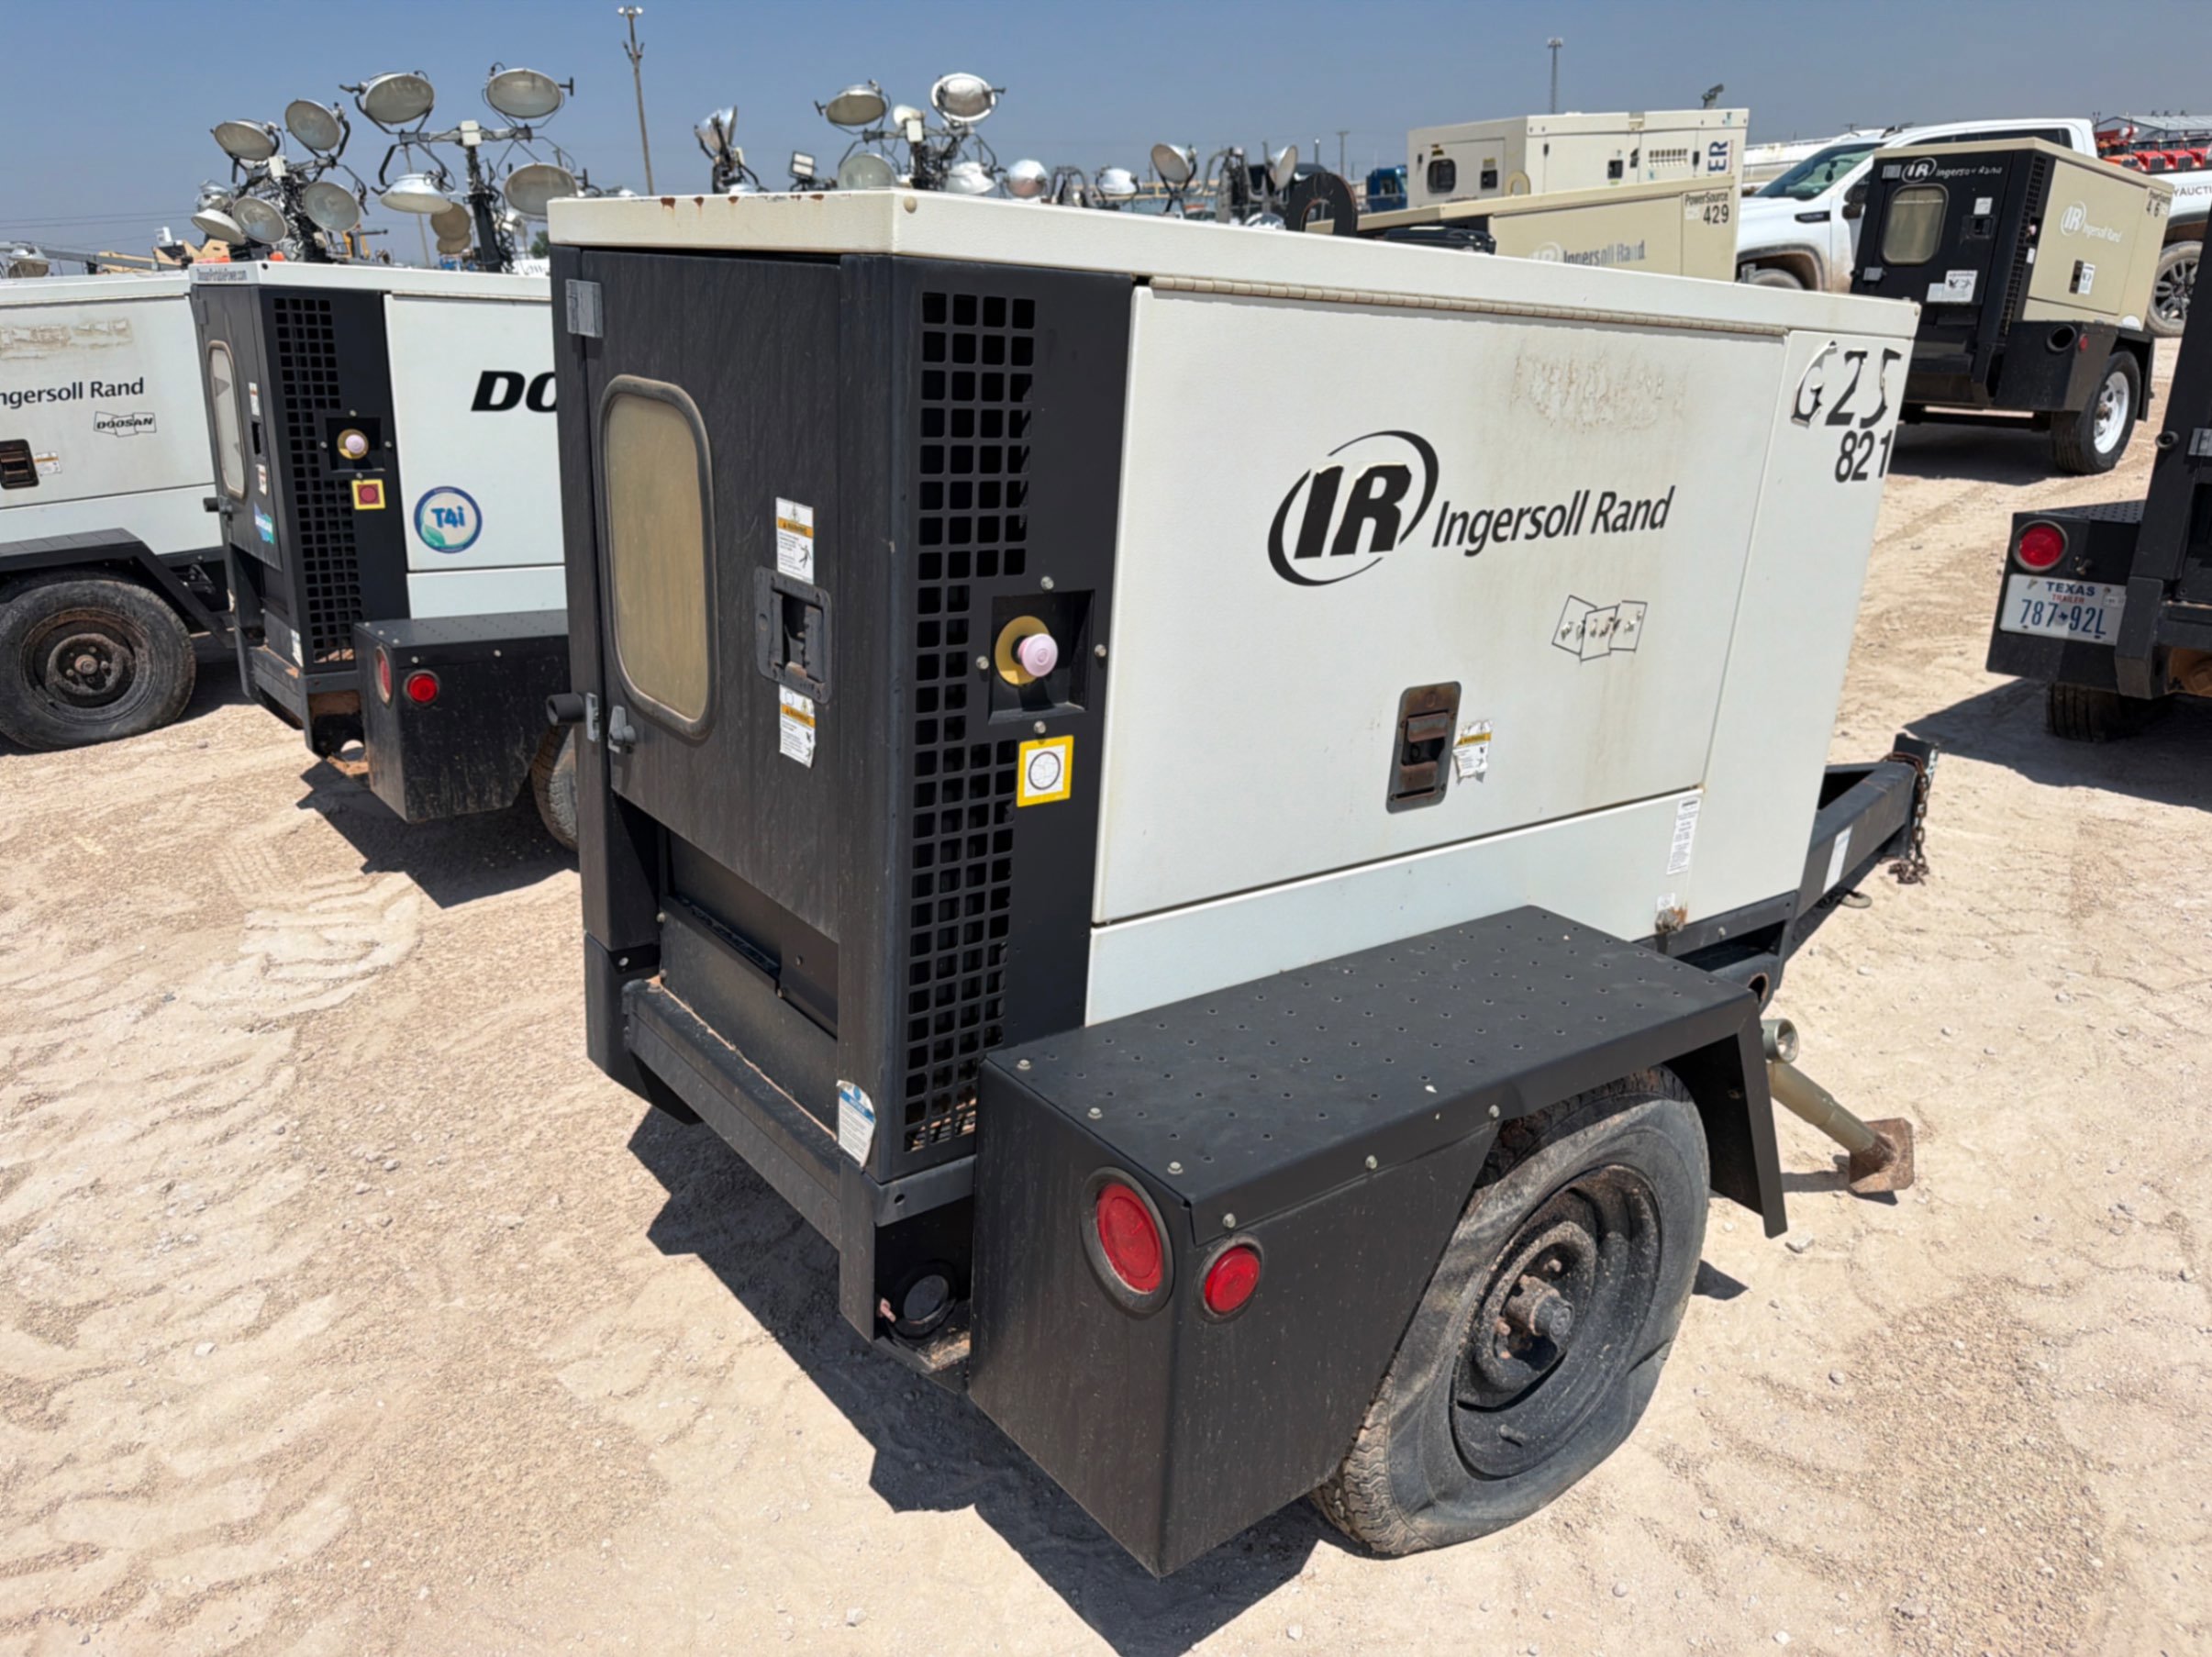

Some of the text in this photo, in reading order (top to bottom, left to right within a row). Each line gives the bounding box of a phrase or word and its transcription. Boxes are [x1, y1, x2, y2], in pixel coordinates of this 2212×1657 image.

[1684, 191, 1729, 206] PowerSource
[1703, 204, 1729, 225] 429
[90, 376, 144, 399] Rand
[471, 370, 557, 414] DO
[96, 417, 153, 430] DOOSAN
[1834, 428, 1894, 484] 821
[1431, 489, 1591, 557] Ingersoll
[1590, 485, 1676, 534] Rand
[2046, 581, 2095, 597] TEXAS
[2052, 593, 2085, 605] TRAILER
